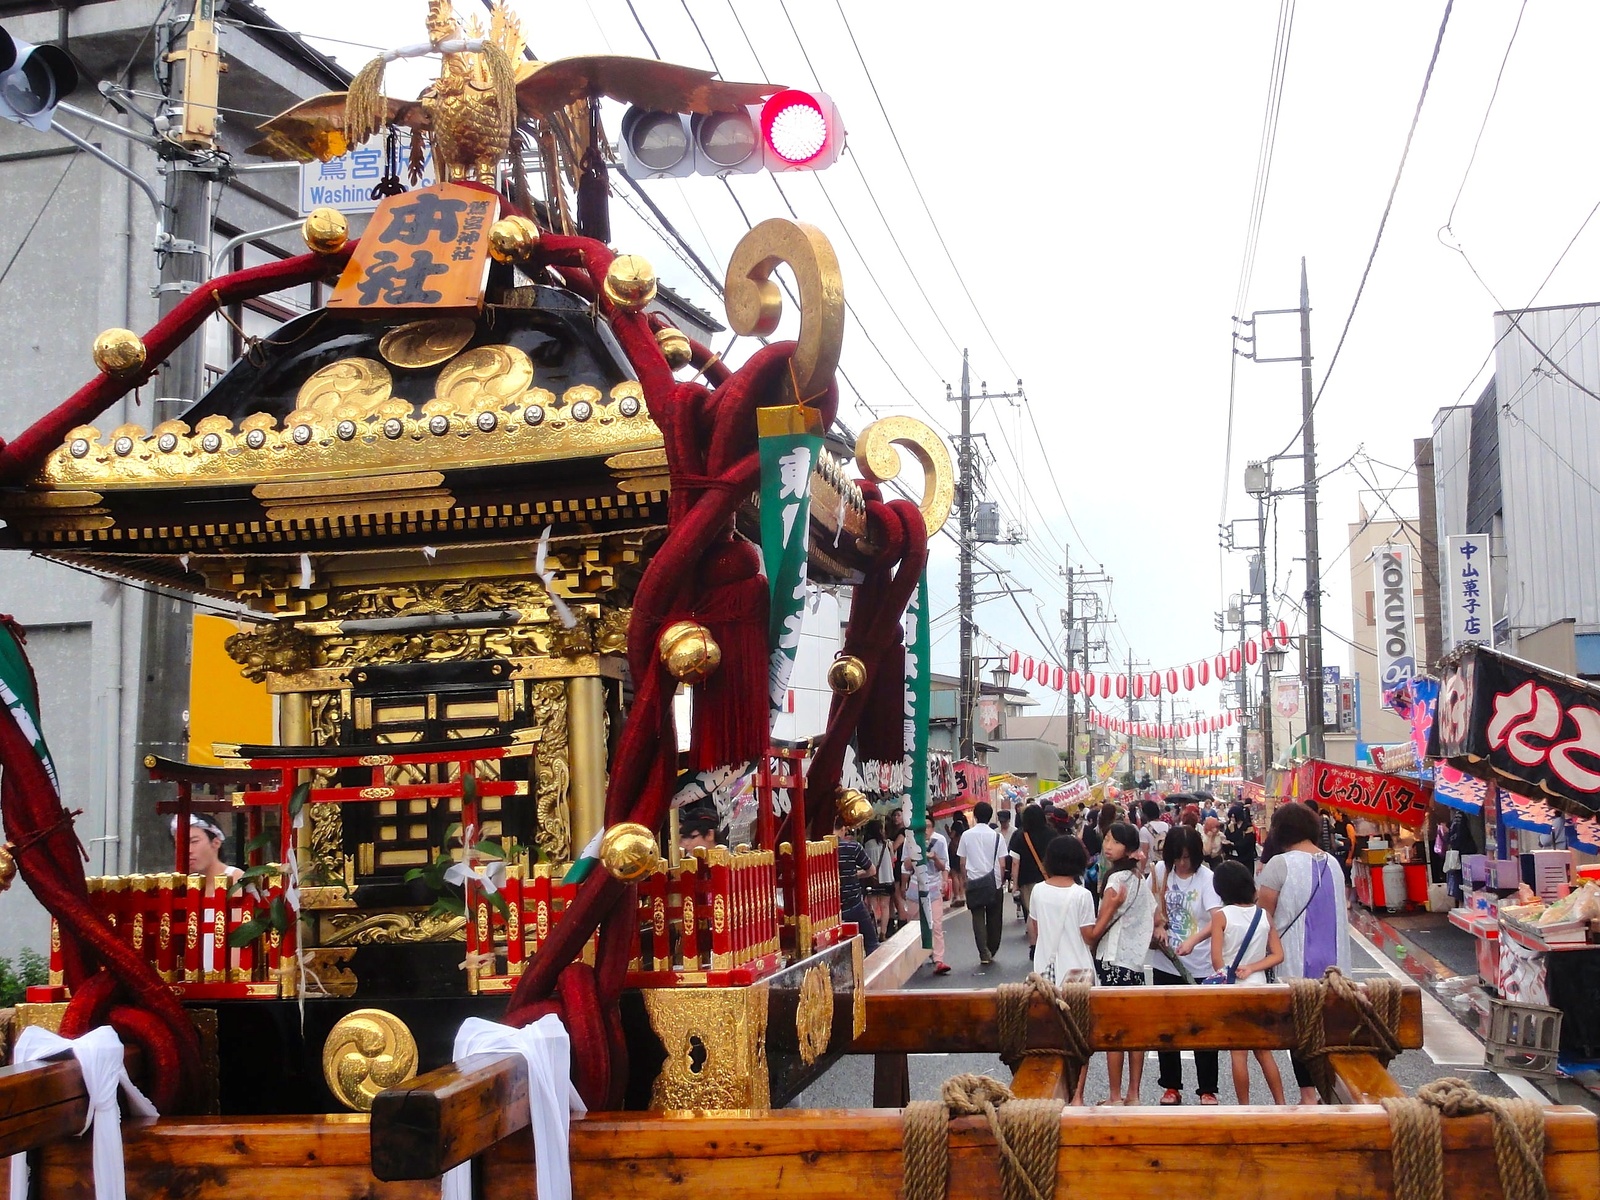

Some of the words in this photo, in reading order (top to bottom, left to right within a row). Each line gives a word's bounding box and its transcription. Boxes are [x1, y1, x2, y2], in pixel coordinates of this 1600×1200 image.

[1382, 552, 1406, 658] KOKUYO
[1459, 541, 1481, 635] 中山菓子店
[1383, 664, 1412, 684] OA
